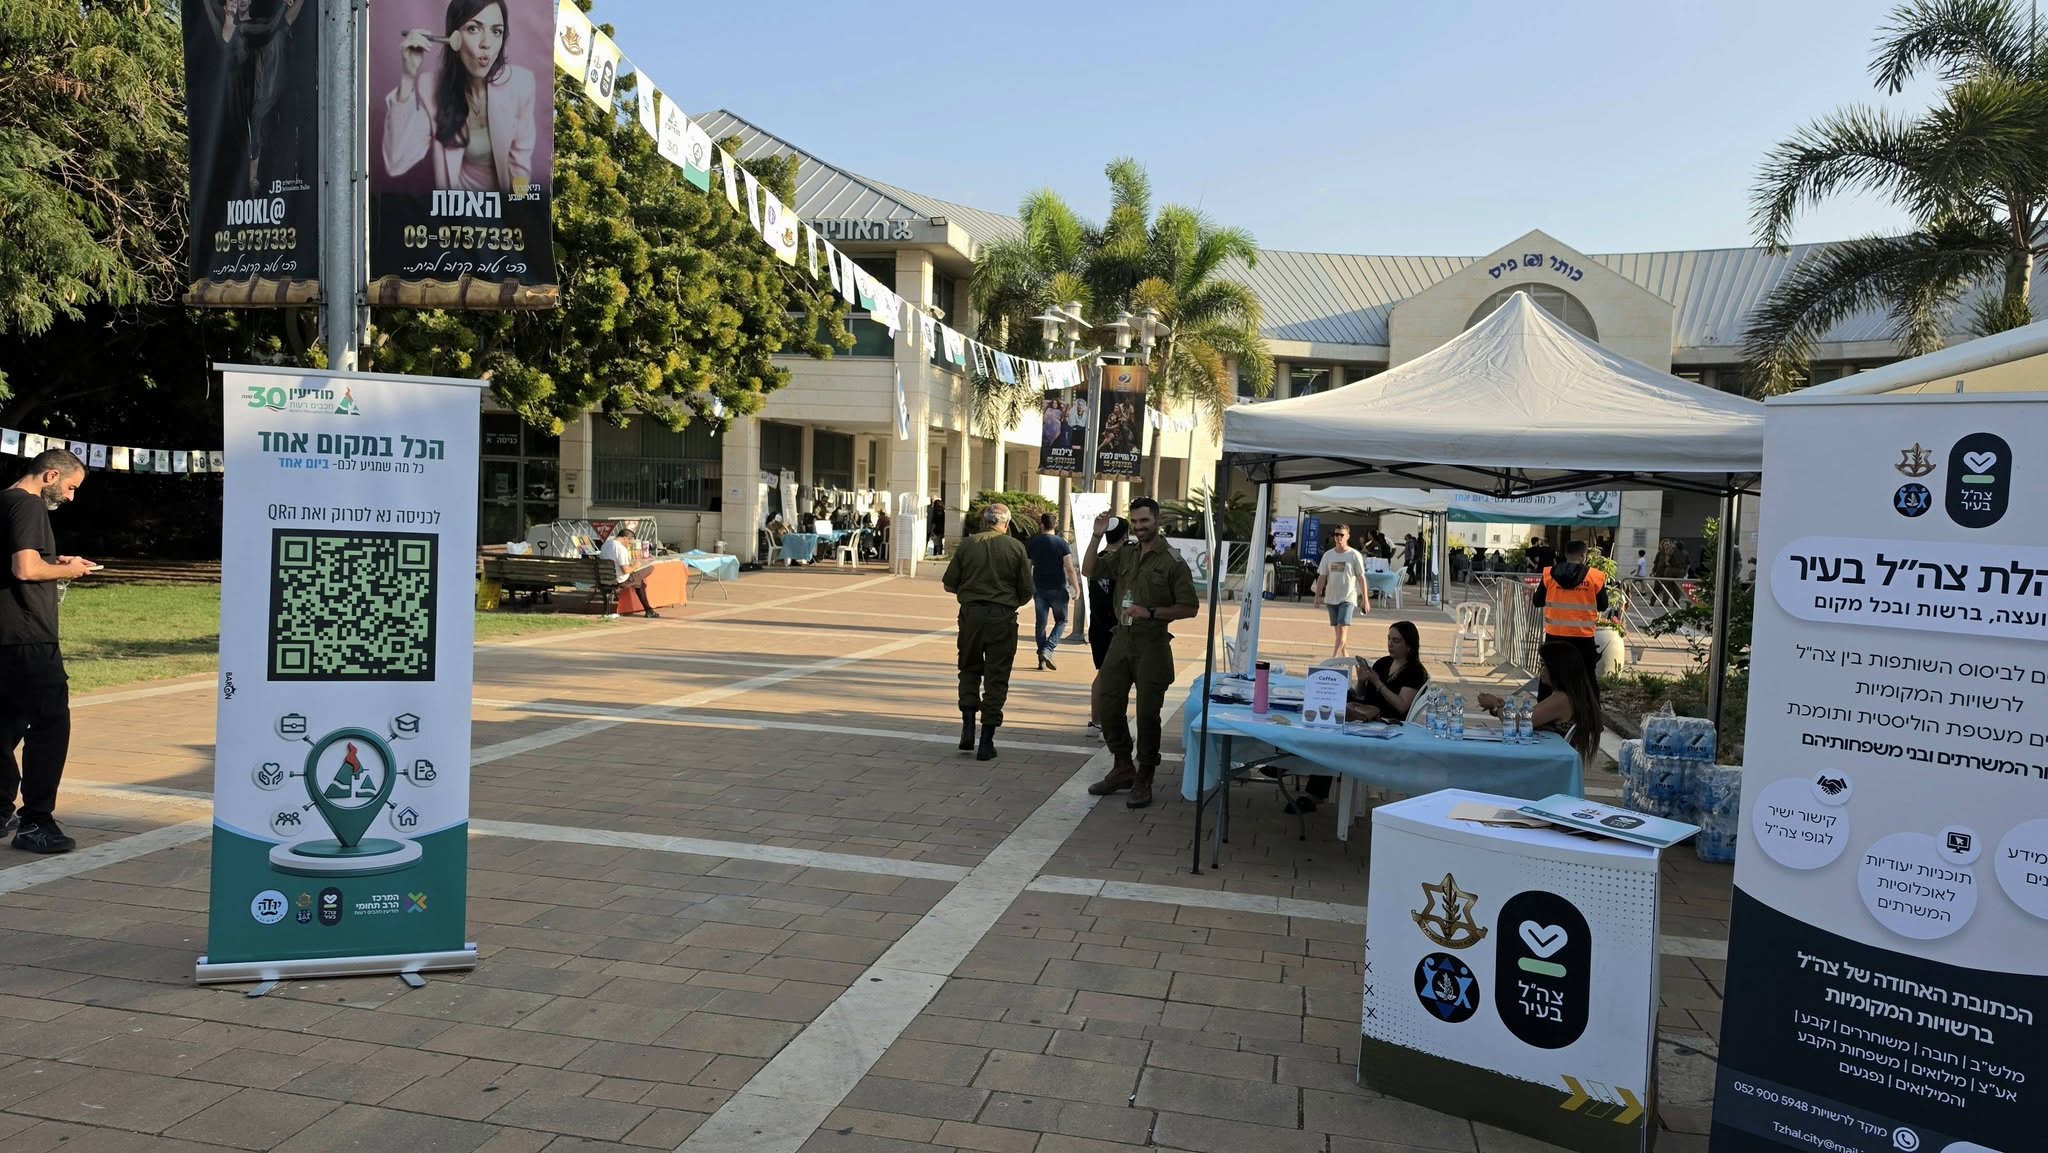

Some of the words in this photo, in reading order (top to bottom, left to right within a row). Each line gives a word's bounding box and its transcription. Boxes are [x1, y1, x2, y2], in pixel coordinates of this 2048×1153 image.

[269, 180, 282, 194] JB
[227, 197, 286, 226] KOOKL@
[430, 189, 502, 219] האמת
[214, 227, 297, 253] 08-9737333
[404, 224, 526, 252] 08-9737333
[240, 263, 260, 281] קרוב
[263, 254, 284, 273] טוב
[281, 260, 297, 271] הכי
[445, 262, 473, 281] קרוב
[477, 255, 508, 274] טוב
[506, 262, 527, 274] הכי
[1488, 258, 1518, 280] פיס
[1550, 255, 1584, 282] כותר
[247, 386, 287, 409] 30
[289, 388, 334, 401] מודיעין
[258, 430, 308, 453] אחד
[317, 433, 393, 459] במקום
[401, 434, 445, 460] הכל
[496, 437, 518, 445] כניסה
[278, 457, 303, 468] אחד
[306, 458, 329, 469] ביום
[360, 461, 391, 473] שמגיע
[395, 462, 409, 473] מה
[412, 463, 424, 474] כל
[1961, 489, 1992, 500] צה"ל
[268, 503, 297, 521] הQR
[301, 505, 326, 521] ואת
[331, 506, 372, 524] לסרוק
[1961, 500, 1991, 511] בעיר
[377, 509, 391, 523] נא
[397, 510, 441, 525] לכניסה
[1790, 554, 1866, 584] בעיר
[1876, 553, 1968, 592] צה״ל
[1814, 595, 1862, 613] מקום
[1869, 597, 1910, 615] ובכל
[1917, 602, 1982, 621] ברשות
[1796, 644, 1836, 662] צה"ל
[1841, 650, 1863, 667] בין
[1868, 653, 1952, 674] השותפות
[1958, 662, 2025, 682] לביסוס
[224, 671, 233, 700] BARON
[1855, 680, 1943, 704] המקומיות
[1786, 701, 1851, 722] ותומכת
[1949, 691, 2024, 713] לרשויות
[1857, 710, 1940, 734] הוליסטית
[1945, 722, 2024, 744] מעטפת
[1801, 732, 1903, 759] משפחותיהם
[1906, 748, 1934, 763] ובני
[1937, 751, 2028, 777] המשרתים
[1768, 804, 1794, 818] ישיר
[1798, 810, 1837, 828] קישור
[1765, 822, 1797, 839] צה״ל
[1801, 830, 1833, 845] לגופי
[1865, 853, 1914, 873] יעודיות
[1917, 864, 1972, 886] תוכניות
[372, 894, 400, 902] המרכז
[1877, 876, 1956, 902] לאוכלוסיות
[355, 902, 380, 910] תחומי
[382, 901, 399, 909] הרב
[1877, 896, 1951, 922] המשרתים
[1797, 951, 1840, 976] צה"ל
[1843, 961, 1870, 984] של
[1518, 980, 1565, 1006] צה"ל
[1874, 972, 1947, 1004] האחודה
[1519, 1000, 1564, 1023] בעיר
[1824, 987, 1913, 1023] המקומיות
[1952, 991, 2034, 1026] הכתובת
[1801, 1012, 1831, 1032] קבע
[1916, 1009, 1995, 1045] ברשויות
[1797, 1031, 1837, 1052] הקבע
[1840, 1024, 1911, 1052] משוחררים
[1839, 1042, 1901, 1070] משפחות
[1921, 1046, 1959, 1066] חובה
[1838, 1061, 1886, 1085] נפגעים
[1911, 1063, 1968, 1088] מילואים
[1970, 1059, 2026, 1083] מלש״ב
[1734, 1081, 1754, 1096] 052
[1756, 1088, 1779, 1103] 900
[1895, 1078, 1967, 1108] והמילואים
[1781, 1095, 1809, 1112] 5948
[1811, 1105, 1855, 1127] לרשויות
[1857, 1119, 1888, 1138] מוקד
